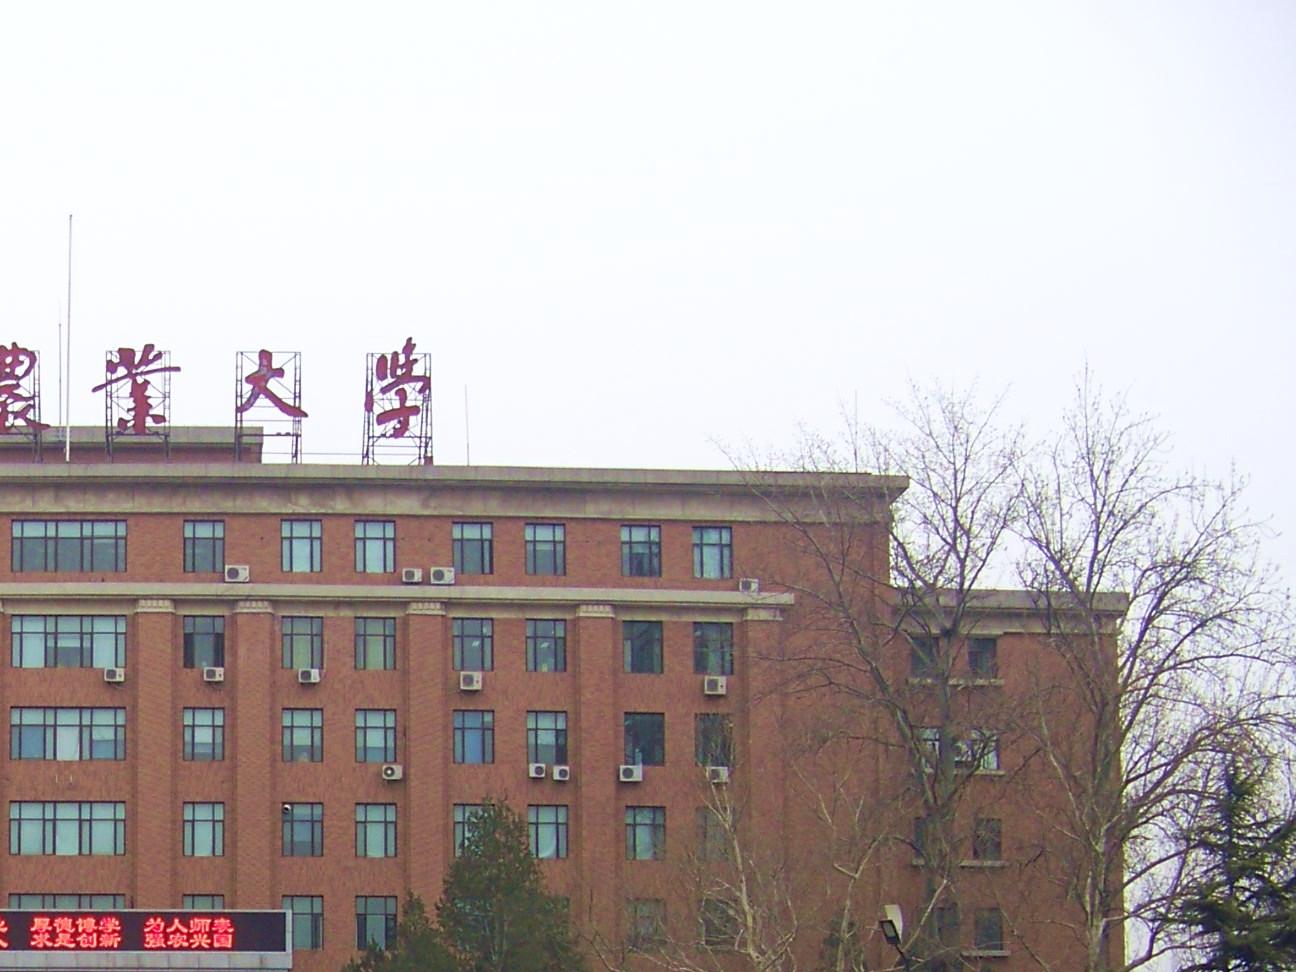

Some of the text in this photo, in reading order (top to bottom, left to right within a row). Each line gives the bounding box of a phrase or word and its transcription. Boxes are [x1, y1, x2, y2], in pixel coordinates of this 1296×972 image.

[30, 916, 121, 932] 厚德博学
[143, 916, 234, 932] 为人师表
[30, 932, 121, 948] 求是创新
[143, 932, 234, 948] 强农兴国
